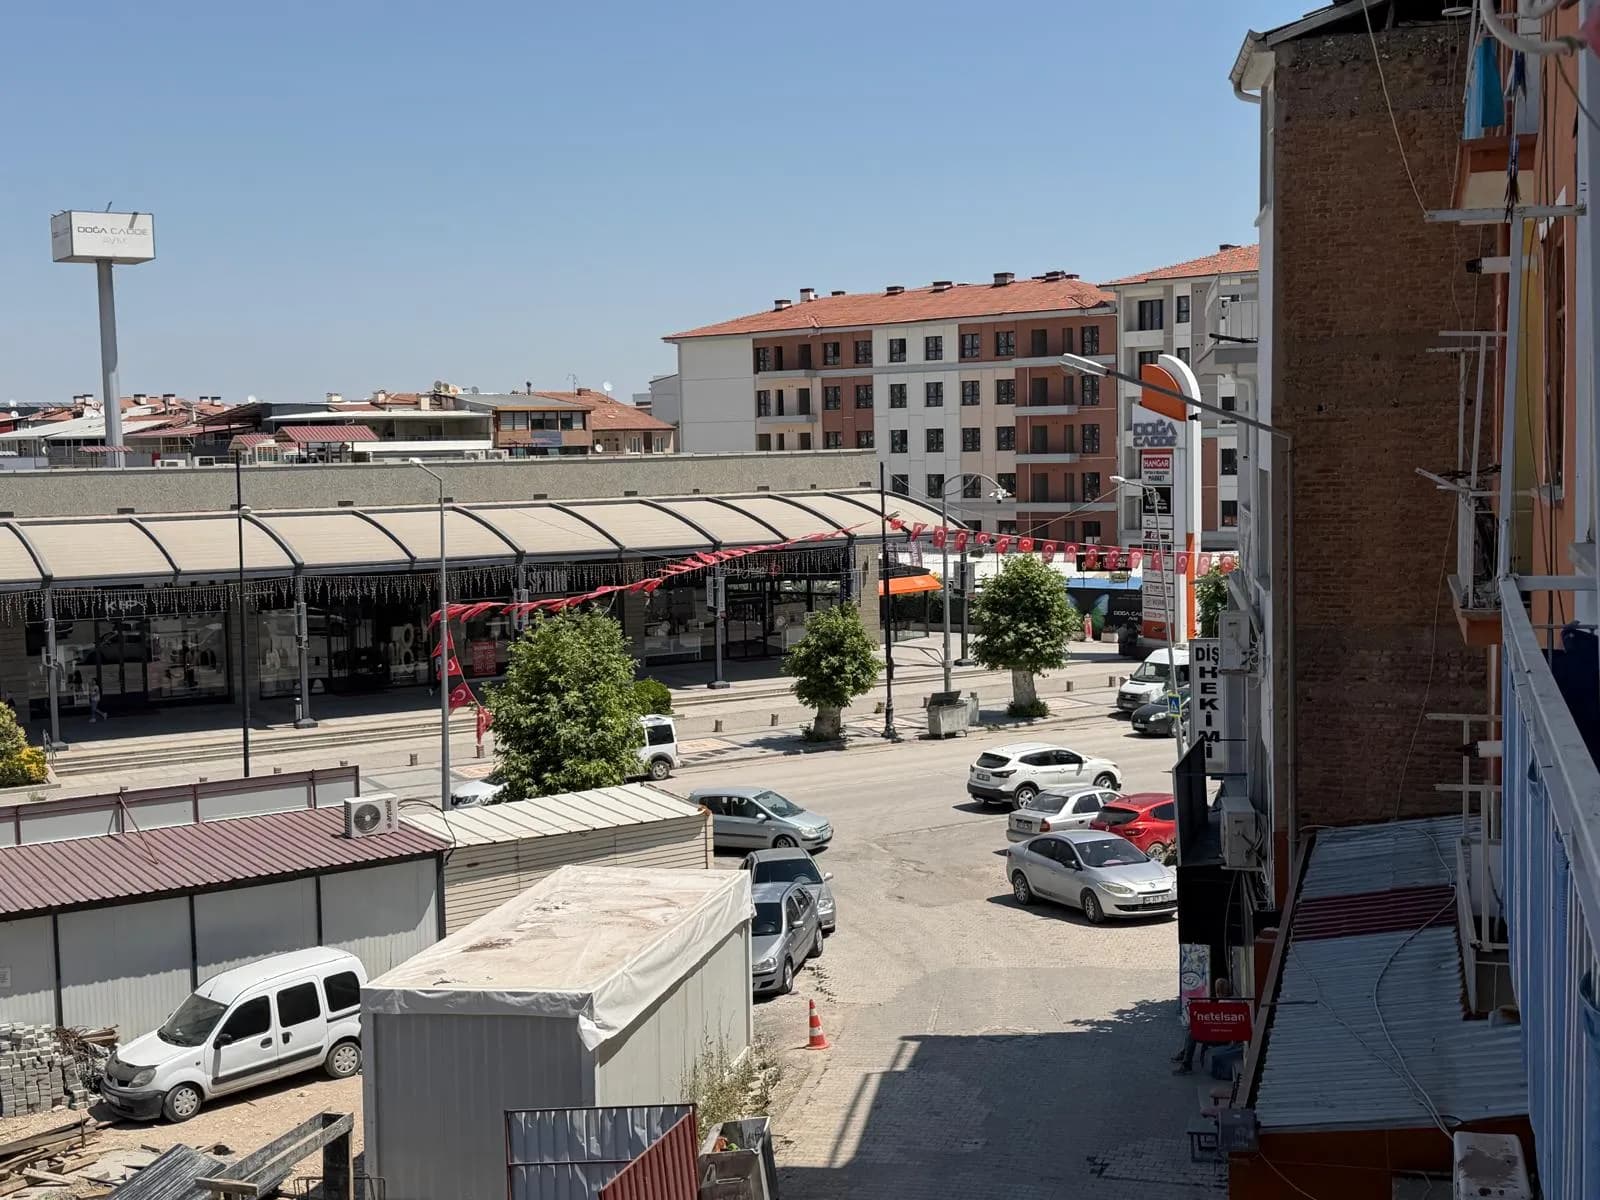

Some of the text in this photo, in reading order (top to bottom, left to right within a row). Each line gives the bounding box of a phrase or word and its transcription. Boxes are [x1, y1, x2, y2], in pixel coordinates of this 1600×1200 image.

[77, 225, 107, 234] DOĞA
[1133, 419, 1177, 436] DOĞA
[1133, 436, 1177, 447] CADDE
[1143, 458, 1169, 469] HANGAR
[1196, 643, 1220, 665] DİŞ
[1196, 1011, 1245, 1022] netelsan
